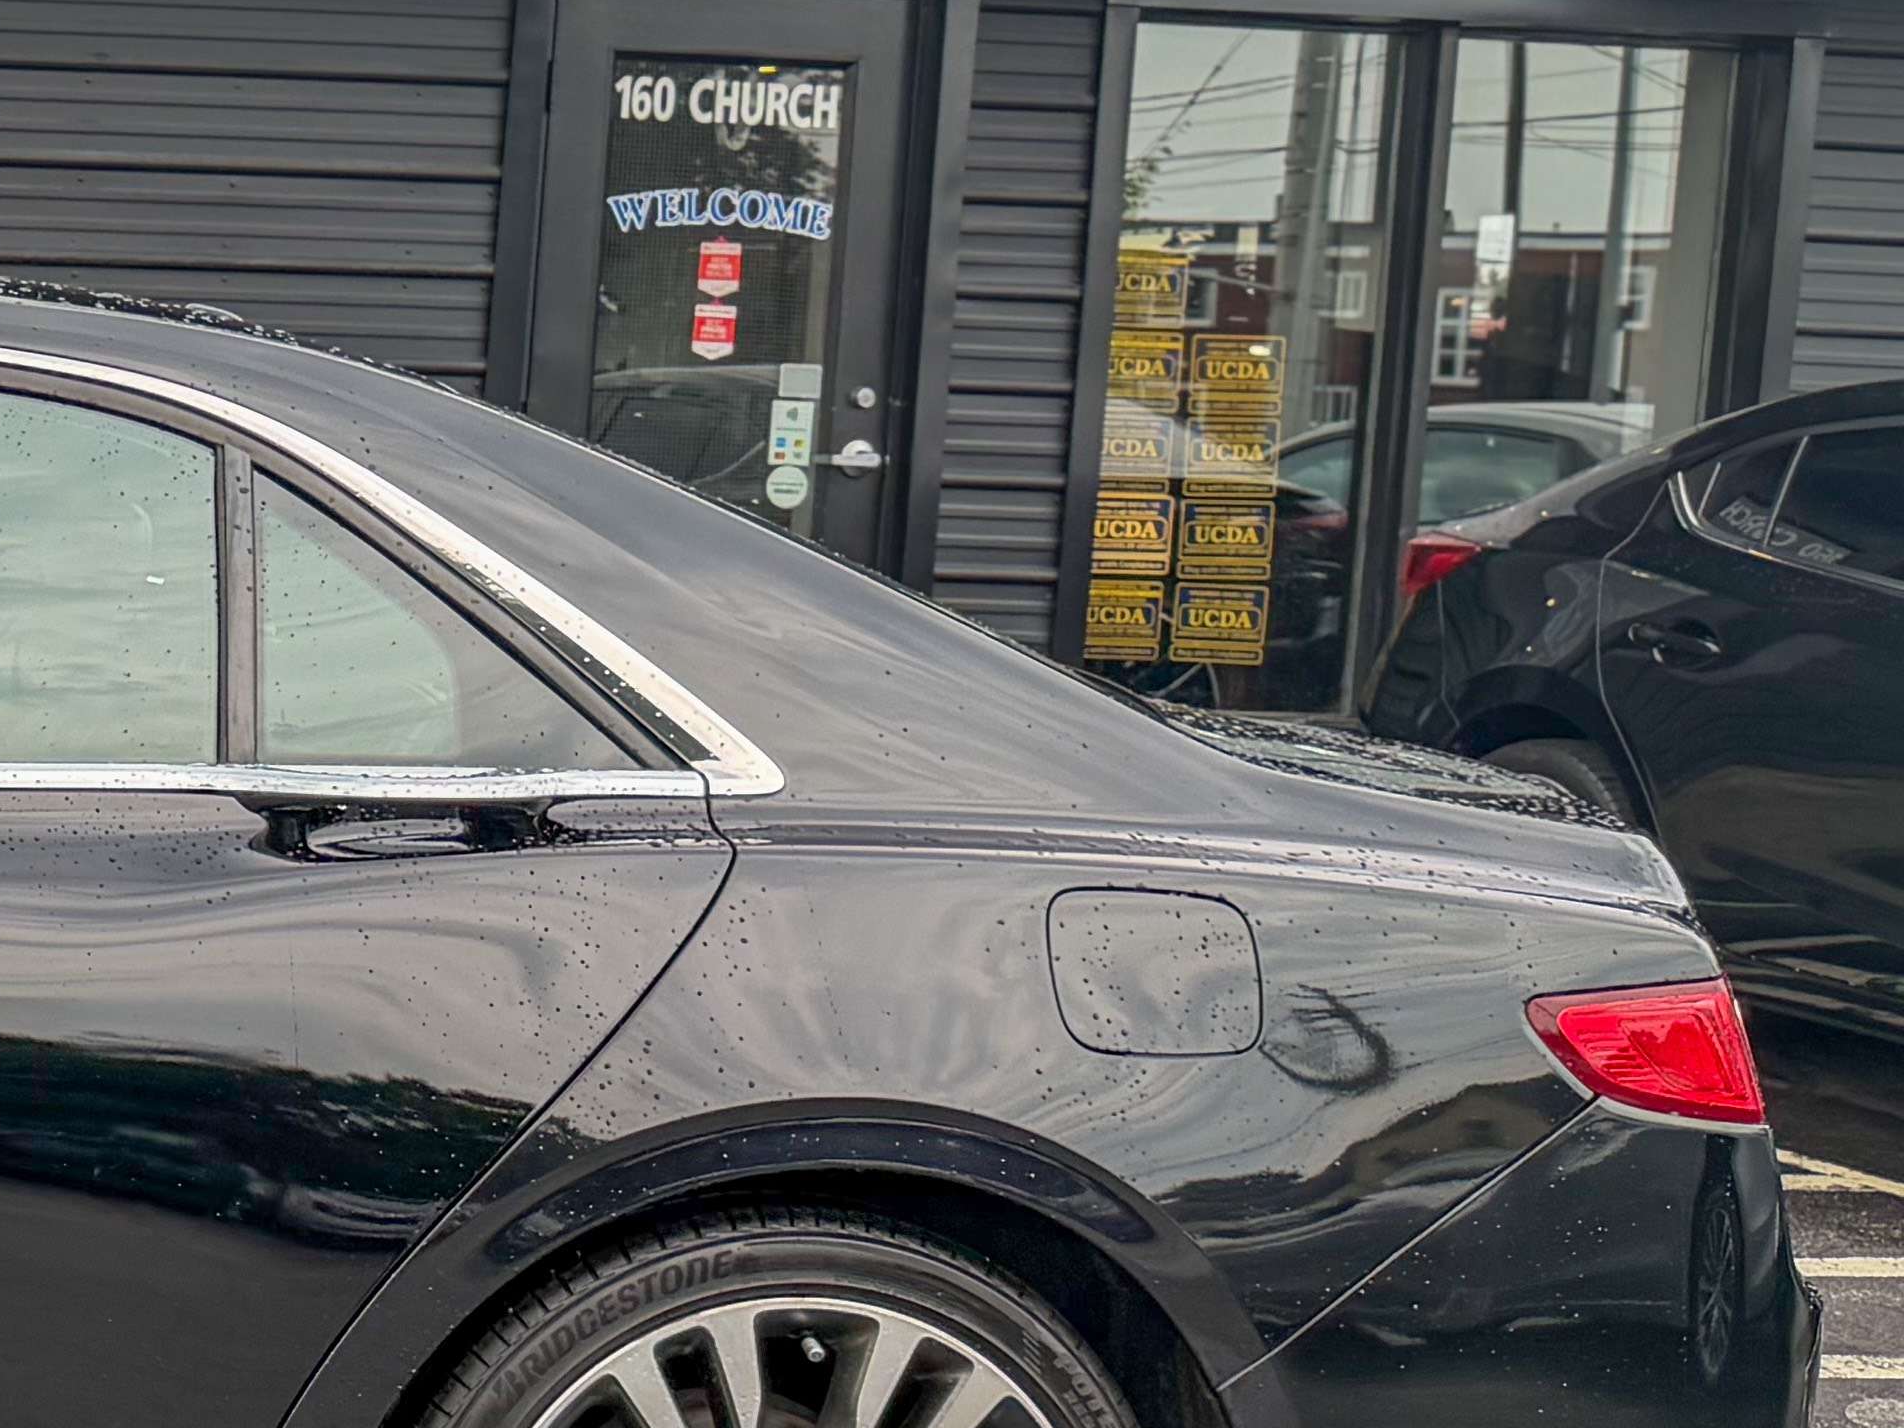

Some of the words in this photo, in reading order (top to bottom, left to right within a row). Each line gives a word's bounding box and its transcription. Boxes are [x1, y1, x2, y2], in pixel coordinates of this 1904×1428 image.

[615, 75, 675, 121] 160
[689, 79, 840, 128] CHURCH
[607, 187, 834, 240] WELCOME
[1206, 361, 1271, 380] UCDA
[1200, 442, 1265, 461] UCDA
[1094, 519, 1159, 539] UCDA
[1195, 525, 1260, 544] UCDA
[1086, 606, 1147, 624] UCDA
[1188, 609, 1253, 629] UCDA
[491, 1249, 733, 1399] BRIDGESTONE
